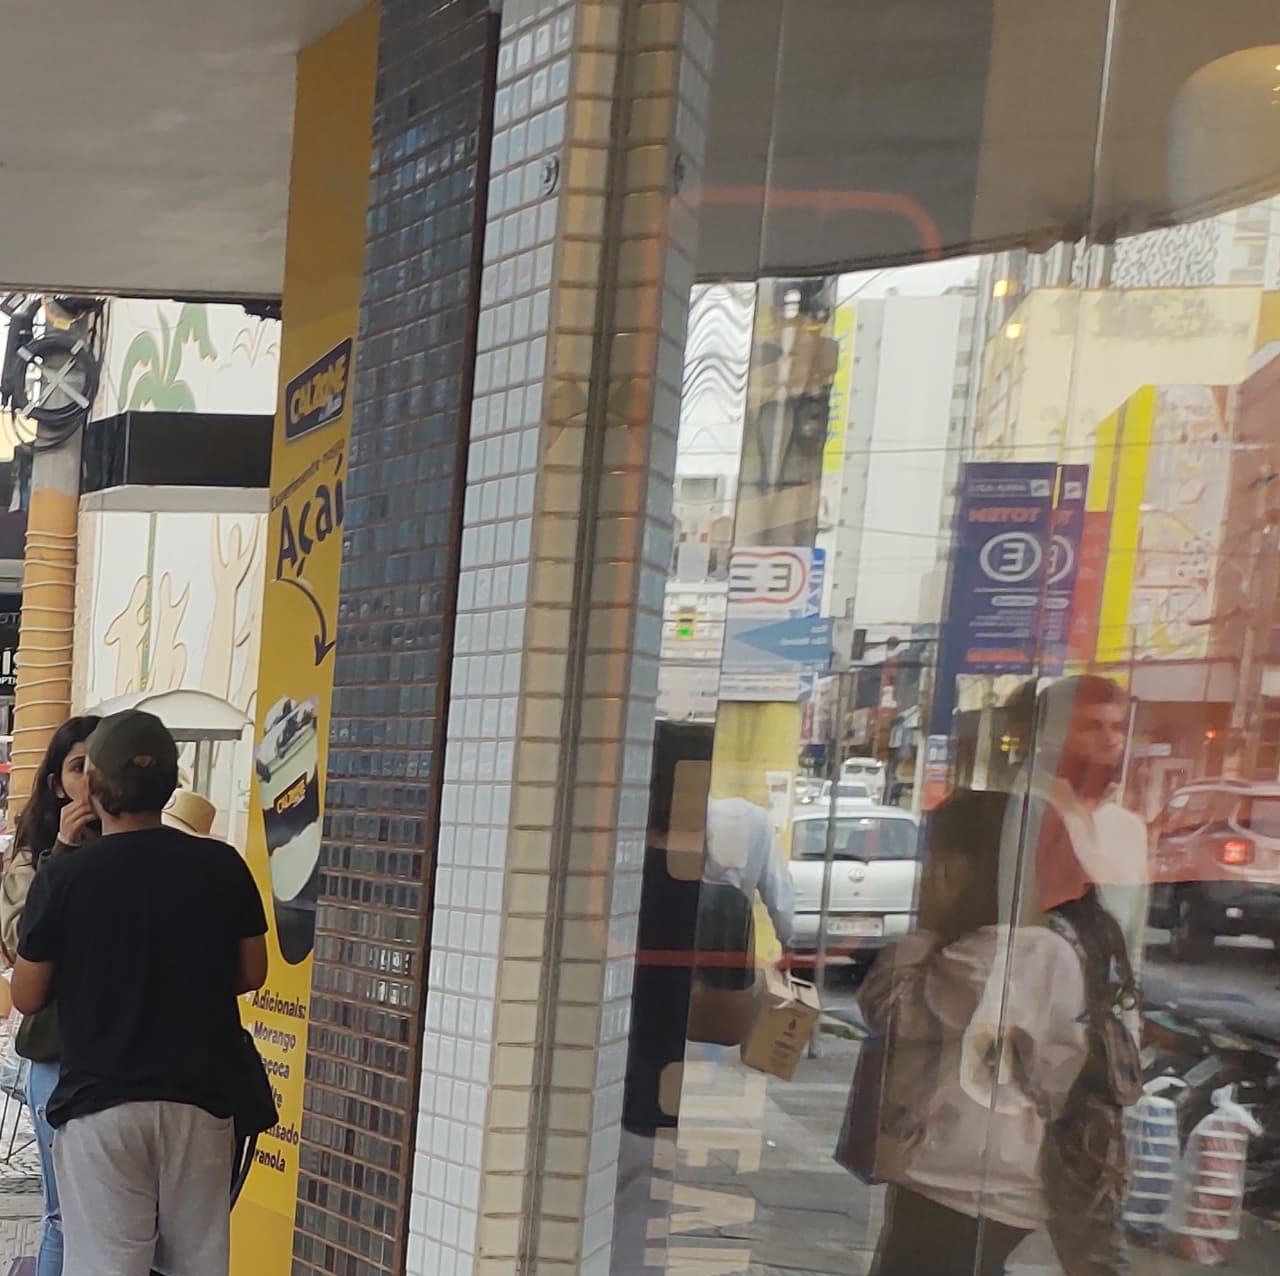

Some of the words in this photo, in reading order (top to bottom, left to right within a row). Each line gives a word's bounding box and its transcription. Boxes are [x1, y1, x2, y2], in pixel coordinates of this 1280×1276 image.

[276, 452, 345, 582] Açaí
[251, 989, 307, 1020] Adicionais:
[254, 1020, 297, 1054] Morango
